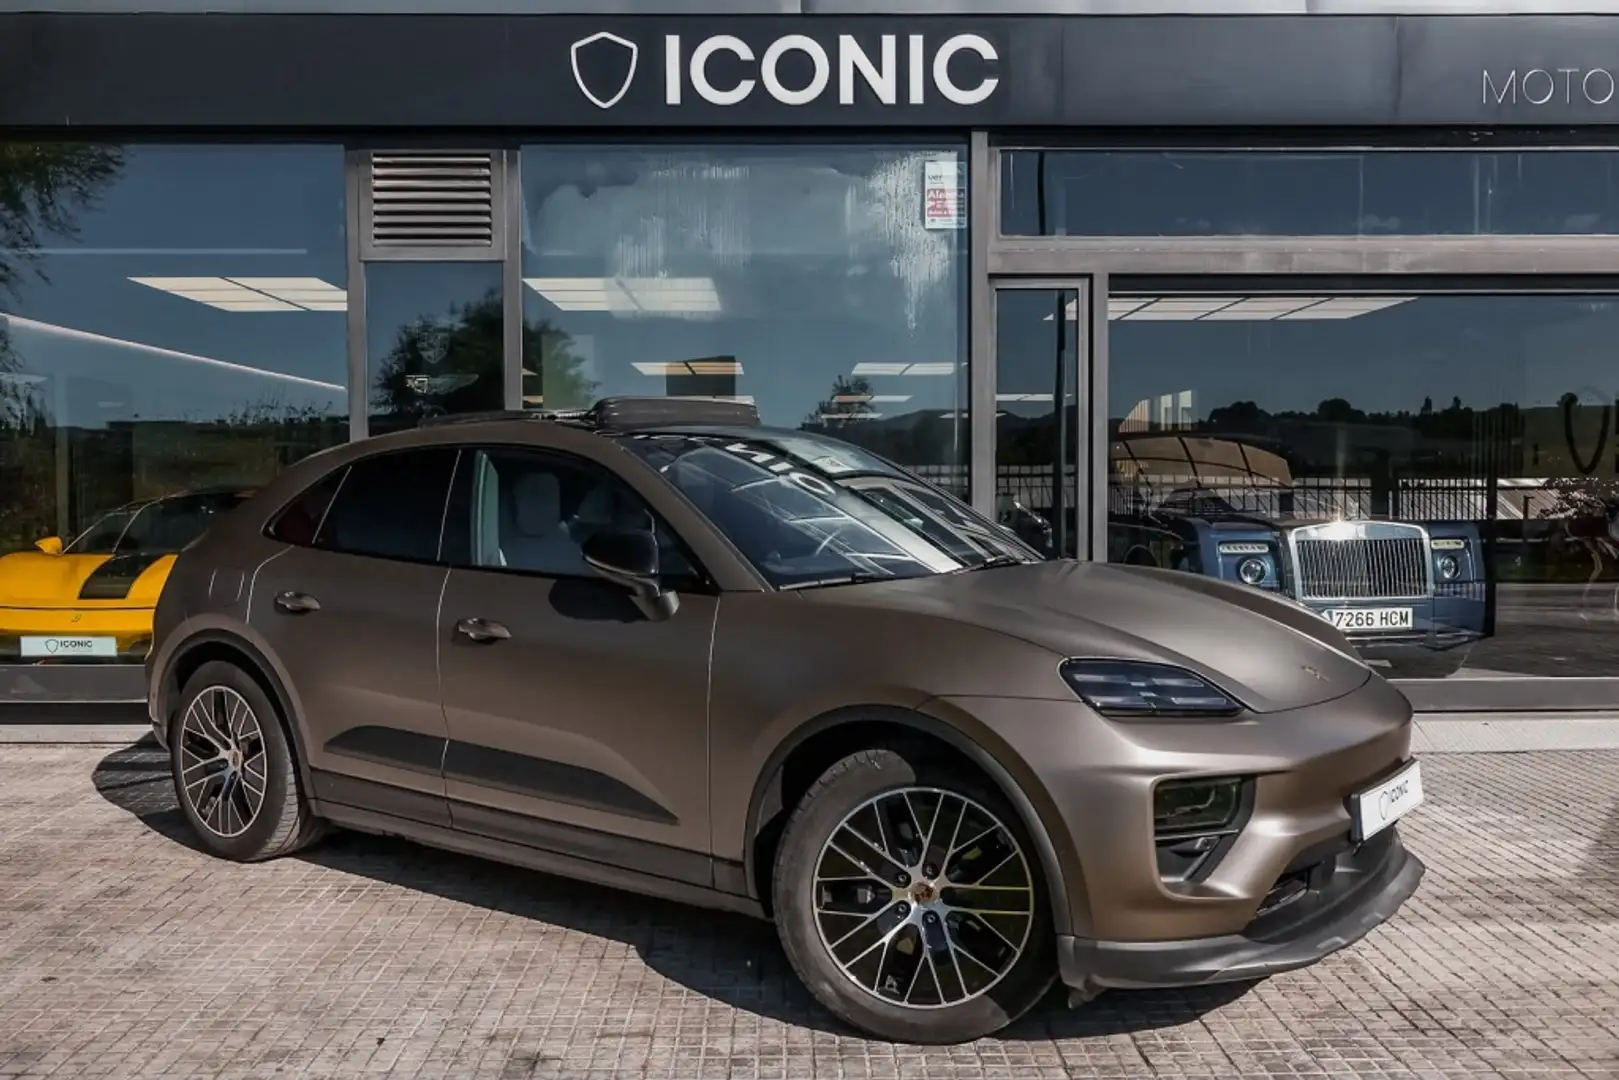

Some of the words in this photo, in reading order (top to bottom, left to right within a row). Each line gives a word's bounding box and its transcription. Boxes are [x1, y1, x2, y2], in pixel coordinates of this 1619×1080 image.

[665, 34, 999, 106] ICONIC
[1482, 67, 1615, 104] MOTO
[1335, 611, 1375, 627] 7266
[1380, 610, 1409, 626] HCM
[60, 640, 93, 648] ICONIC
